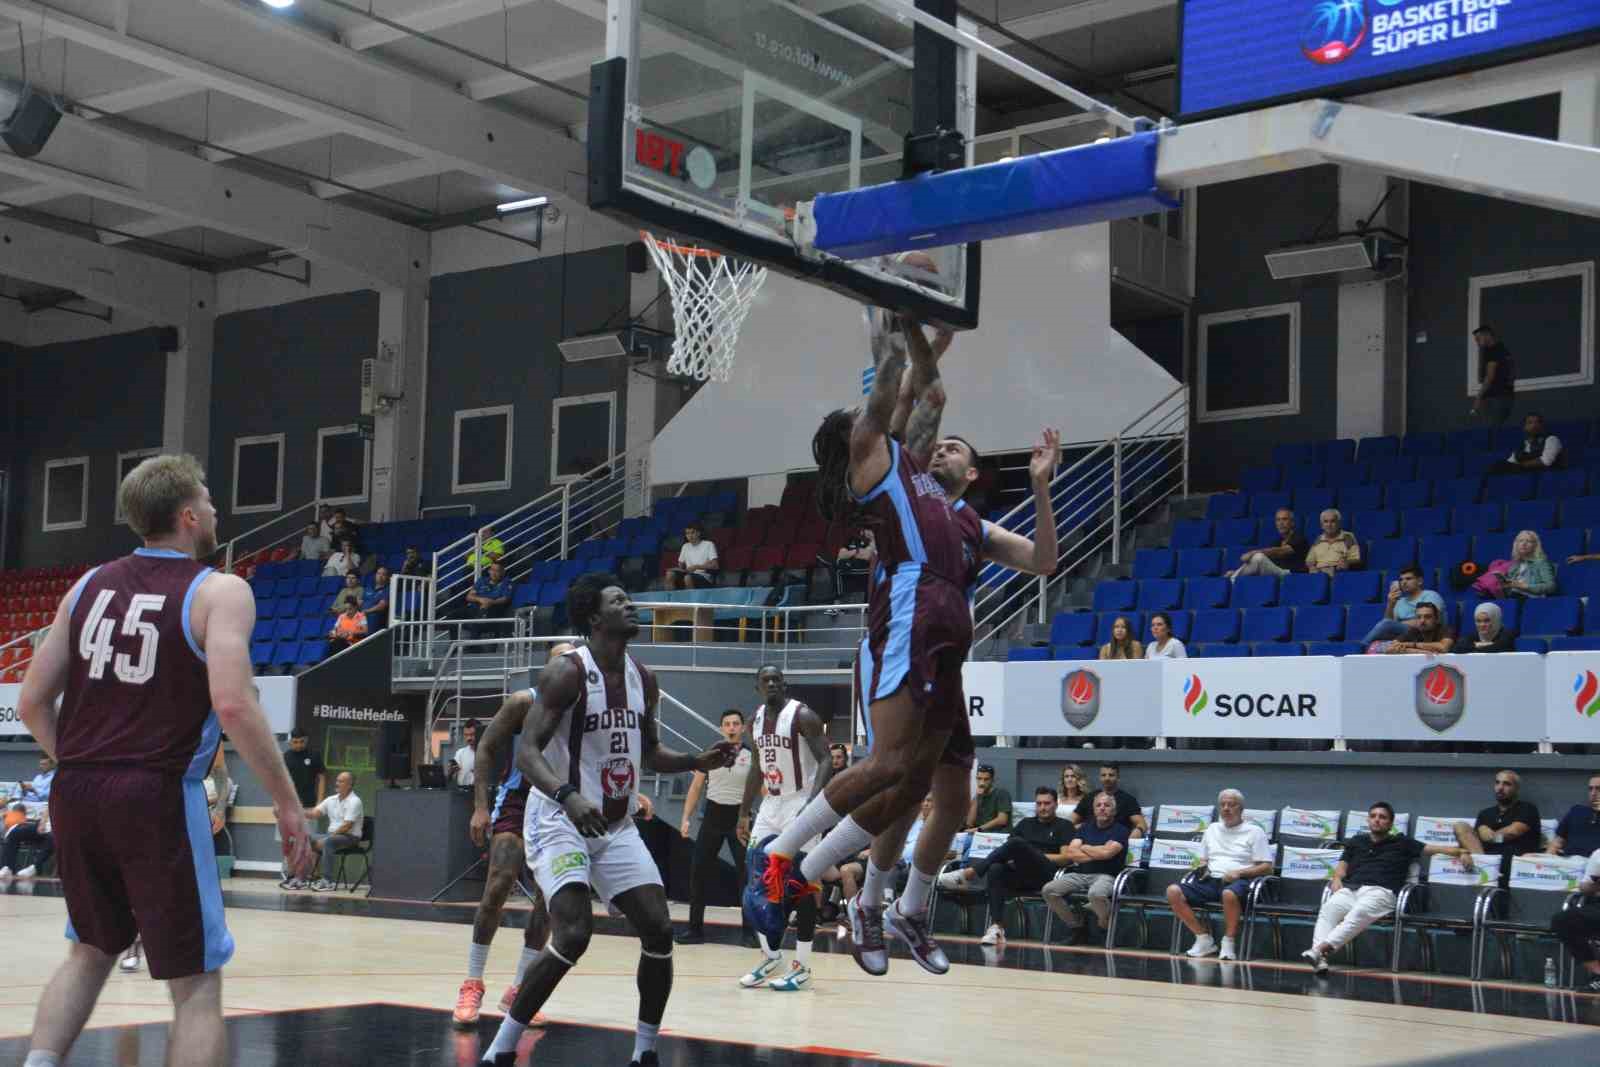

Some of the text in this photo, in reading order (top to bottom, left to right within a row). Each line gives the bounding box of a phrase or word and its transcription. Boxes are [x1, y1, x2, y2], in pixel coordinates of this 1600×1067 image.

[1372, 0, 1512, 33] BASKETBO
[1372, 8, 1497, 56] SÜPER LİGİ
[79, 589, 166, 684] 45
[1214, 693, 1317, 718] SOCAR
[610, 731, 629, 754] 21
[754, 734, 792, 749] ORDO
[765, 748, 776, 763] 23
